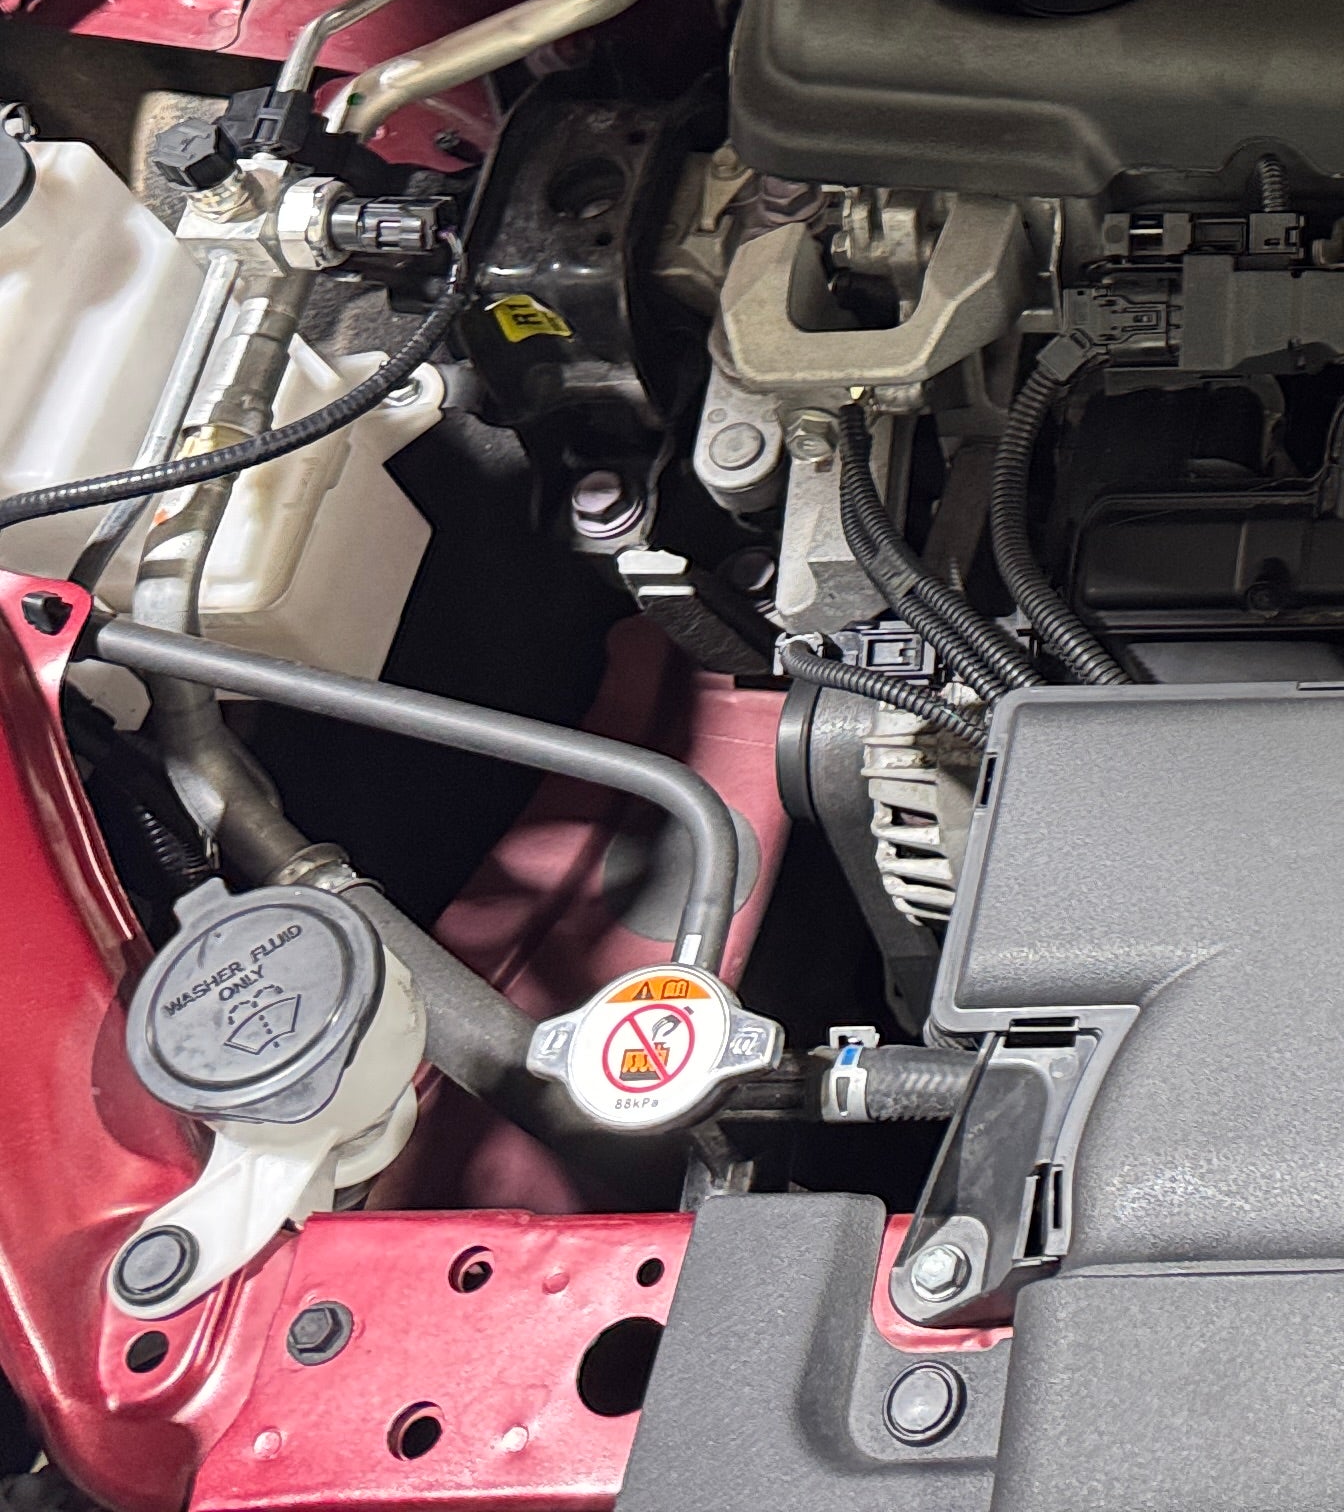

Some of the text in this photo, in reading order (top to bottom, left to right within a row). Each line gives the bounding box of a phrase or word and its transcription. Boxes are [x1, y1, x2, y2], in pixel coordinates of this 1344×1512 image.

[163, 923, 303, 1019] WASHER FLUID
[217, 965, 266, 1003] ONLY
[614, 1097, 659, 1111] 88kPa
